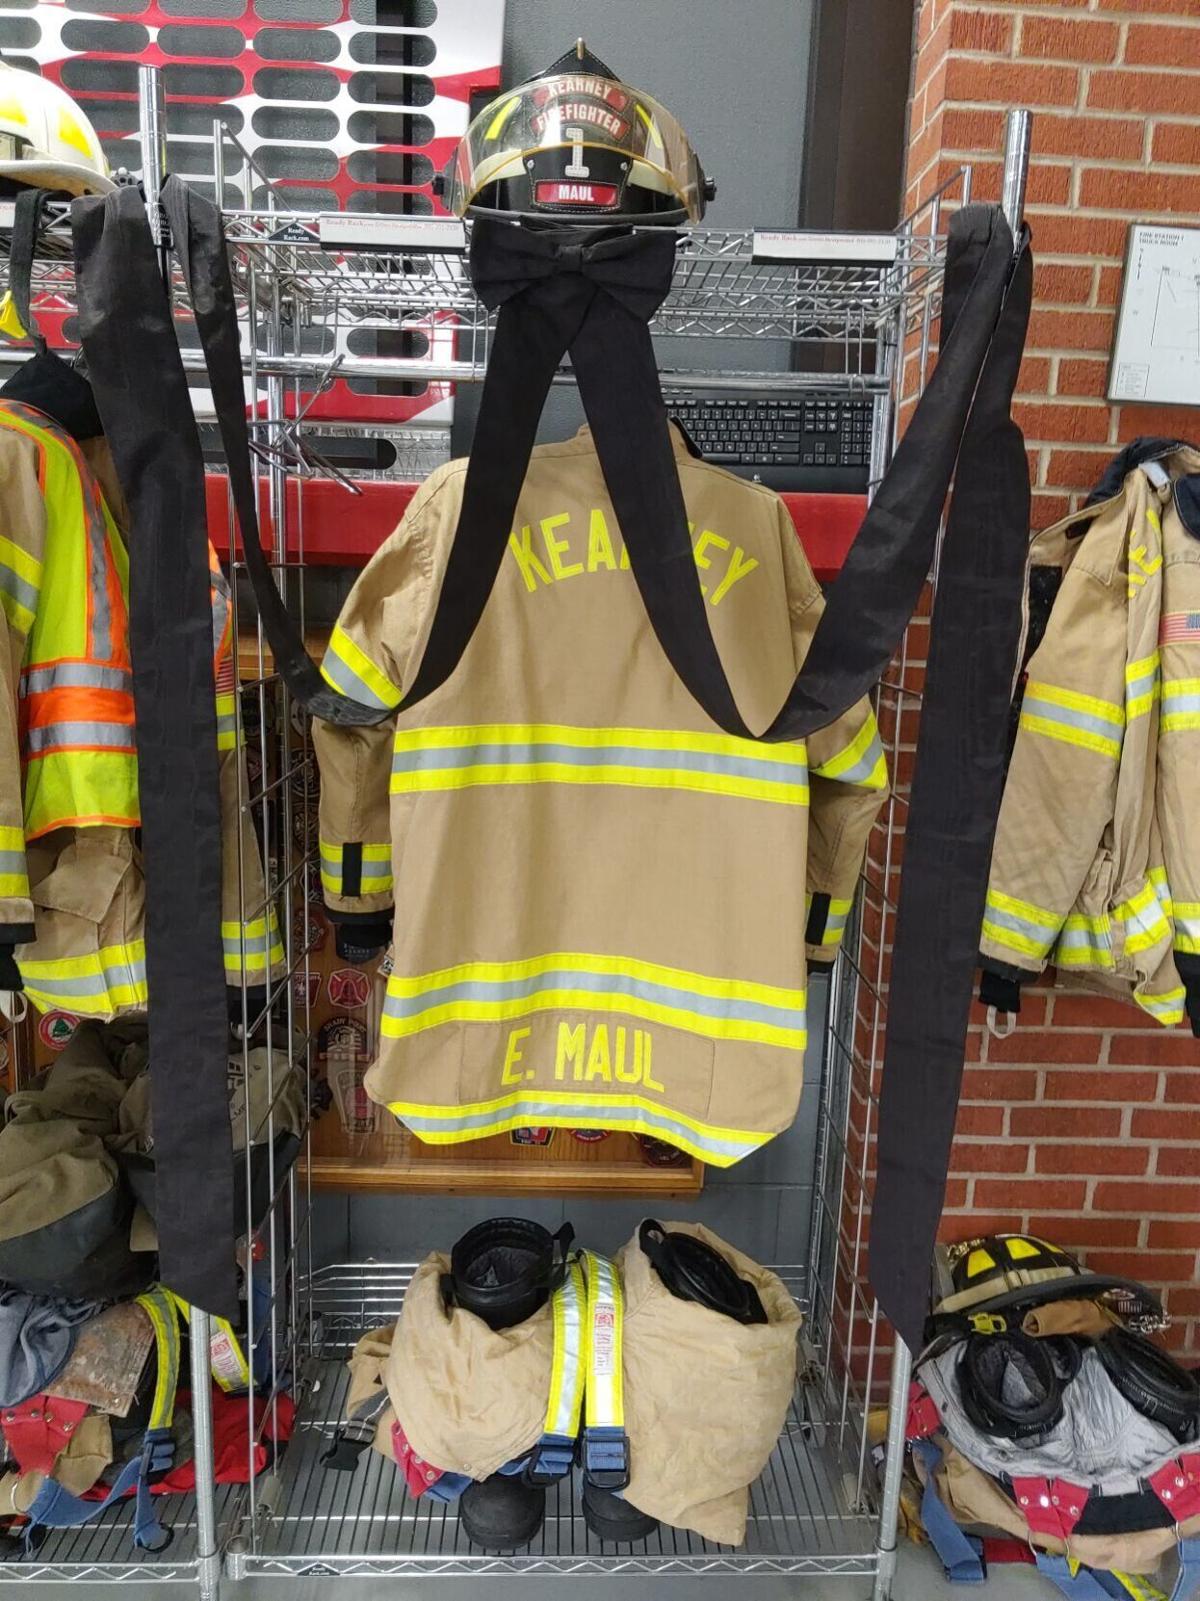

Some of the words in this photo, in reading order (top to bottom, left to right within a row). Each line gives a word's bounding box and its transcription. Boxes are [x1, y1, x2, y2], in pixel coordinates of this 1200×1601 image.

[547, 76, 612, 100] KEARNEY
[565, 128, 590, 178] 1
[558, 184, 594, 201] MAUL
[508, 508, 759, 606] KEAEY
[501, 1027, 535, 1086] E.
[555, 1021, 665, 1093] MAUL
